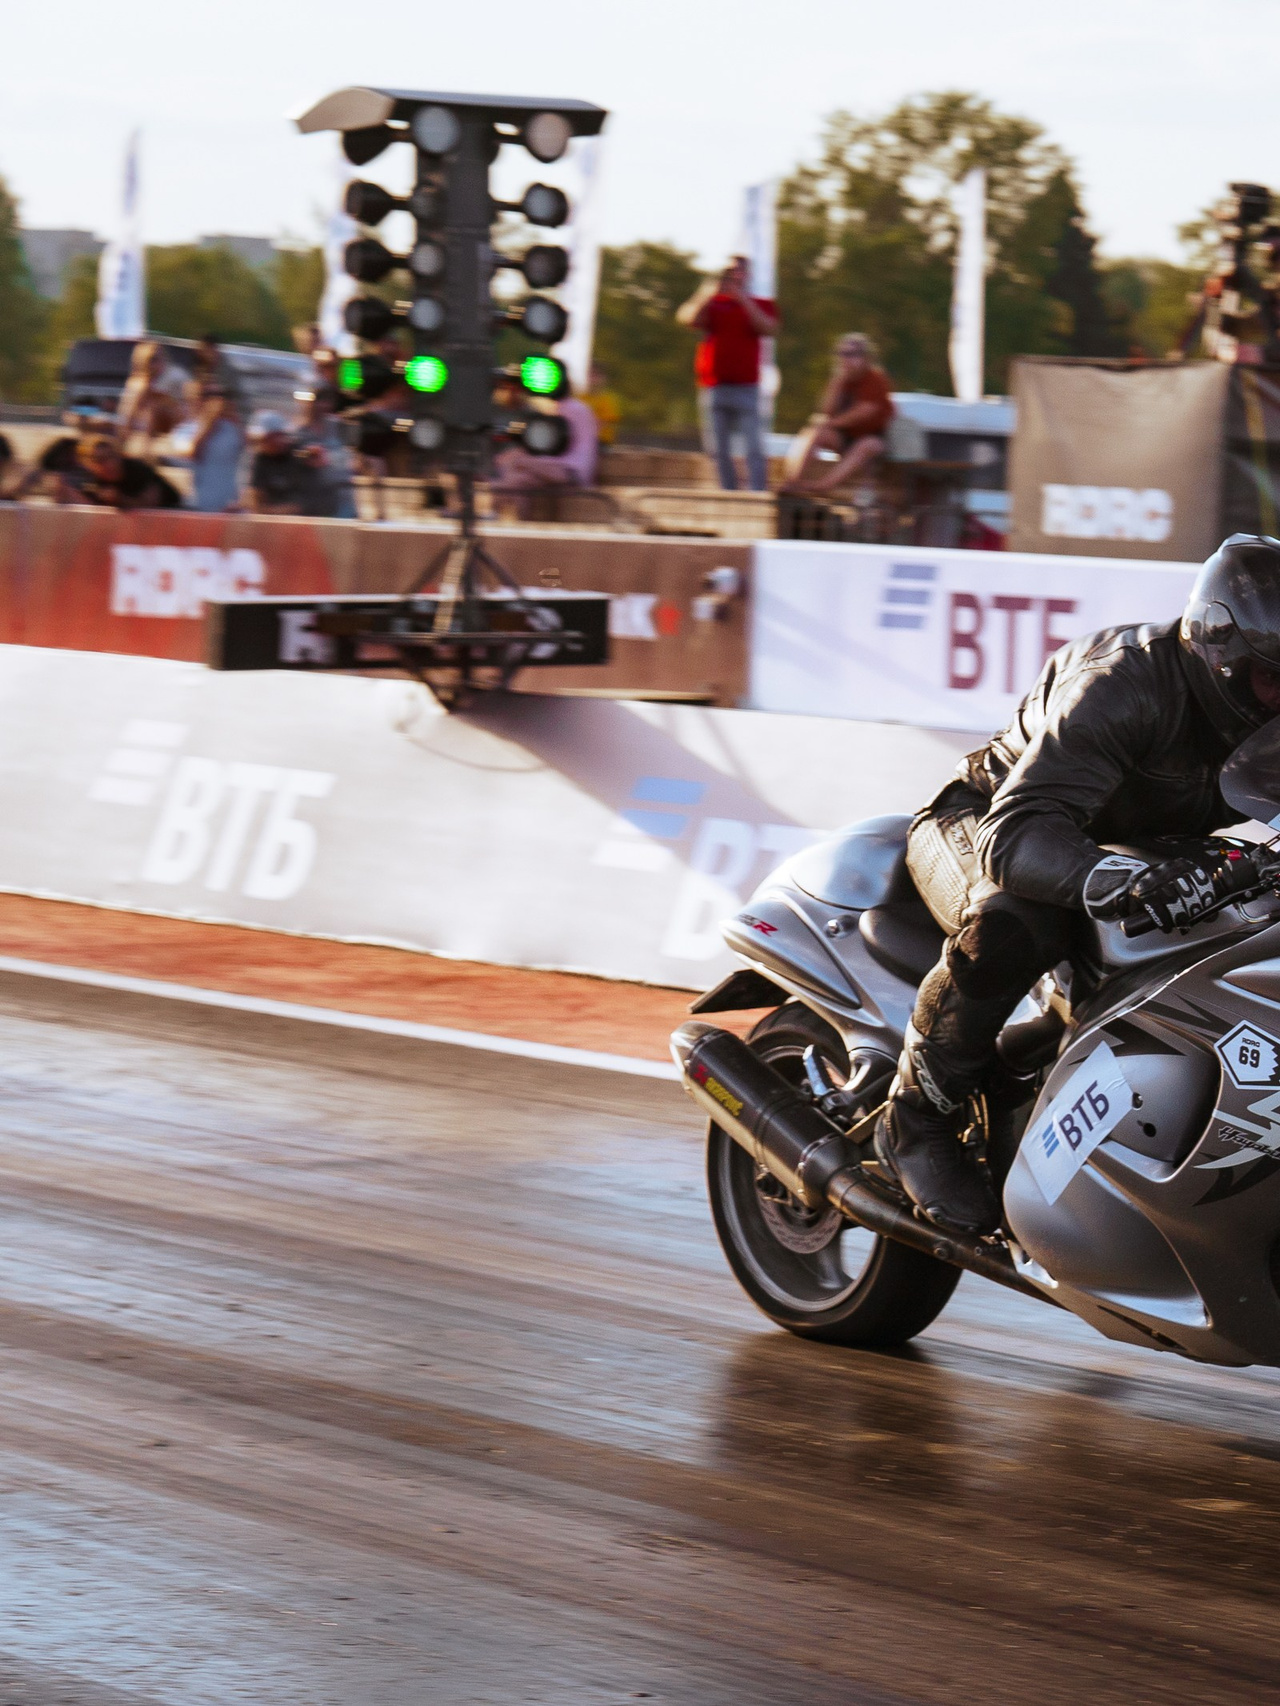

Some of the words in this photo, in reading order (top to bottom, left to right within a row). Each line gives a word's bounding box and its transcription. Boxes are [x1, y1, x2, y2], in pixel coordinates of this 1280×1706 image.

[142, 755, 338, 901] ВТБ
[1239, 1045, 1260, 1068] 69
[1059, 1080, 1109, 1151] ВТБ
